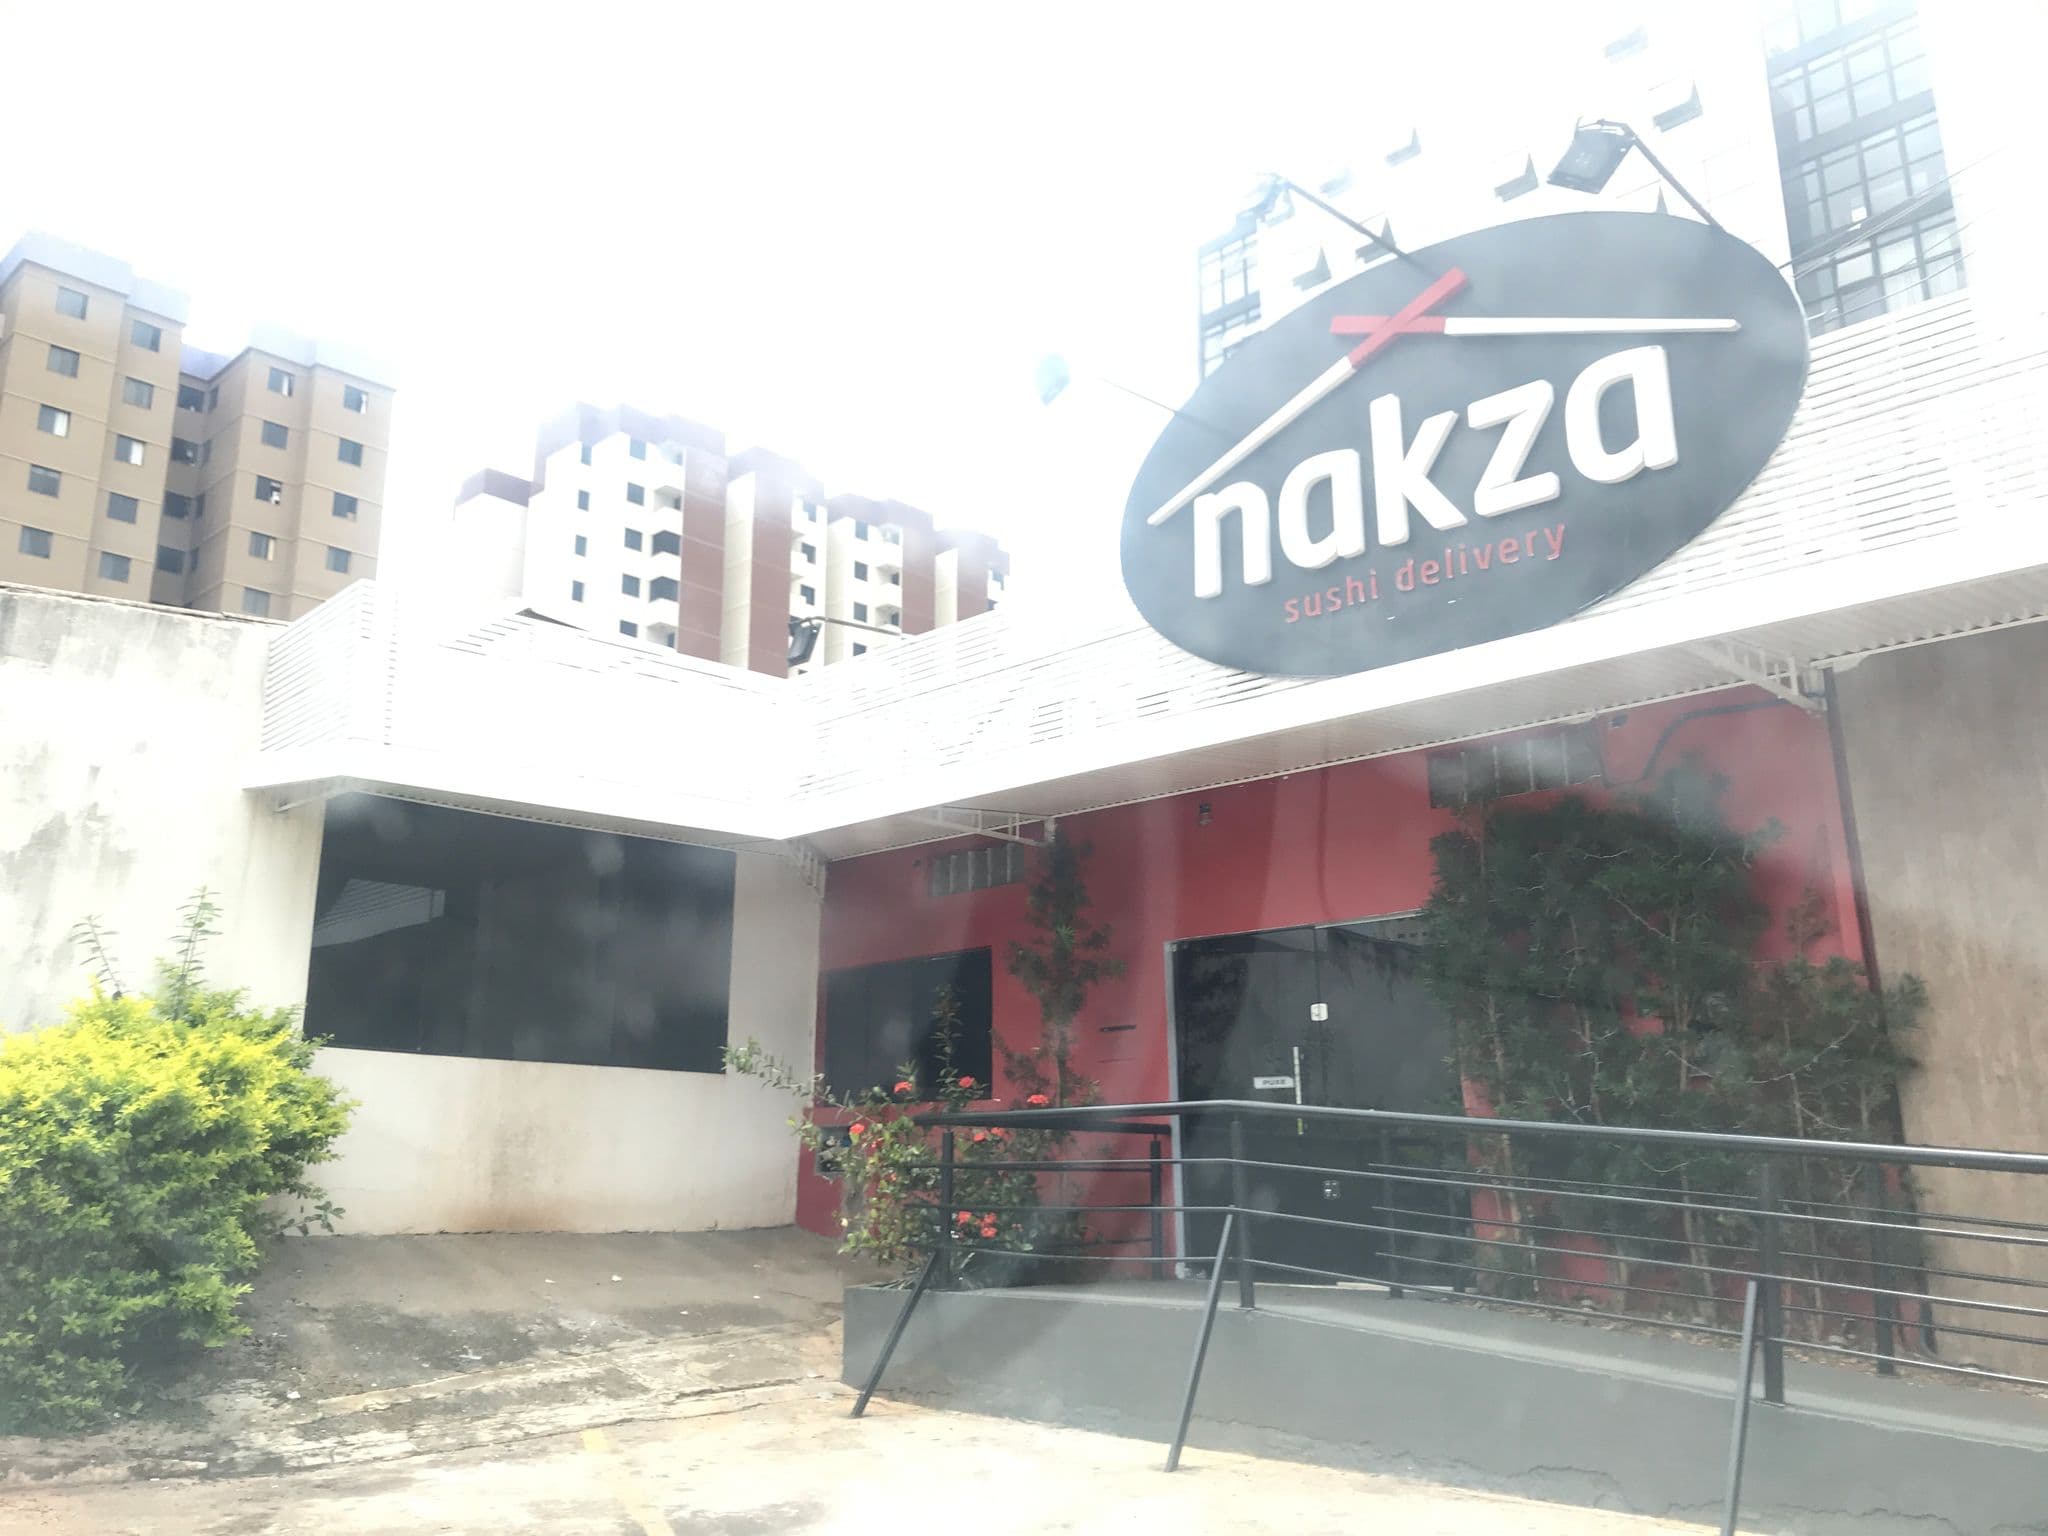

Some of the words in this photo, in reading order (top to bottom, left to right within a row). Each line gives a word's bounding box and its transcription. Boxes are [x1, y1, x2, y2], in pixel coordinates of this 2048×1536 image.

[1194, 345, 1679, 598] nakza
[1284, 569, 1379, 624] sushi
[1395, 523, 1566, 592] delivery
